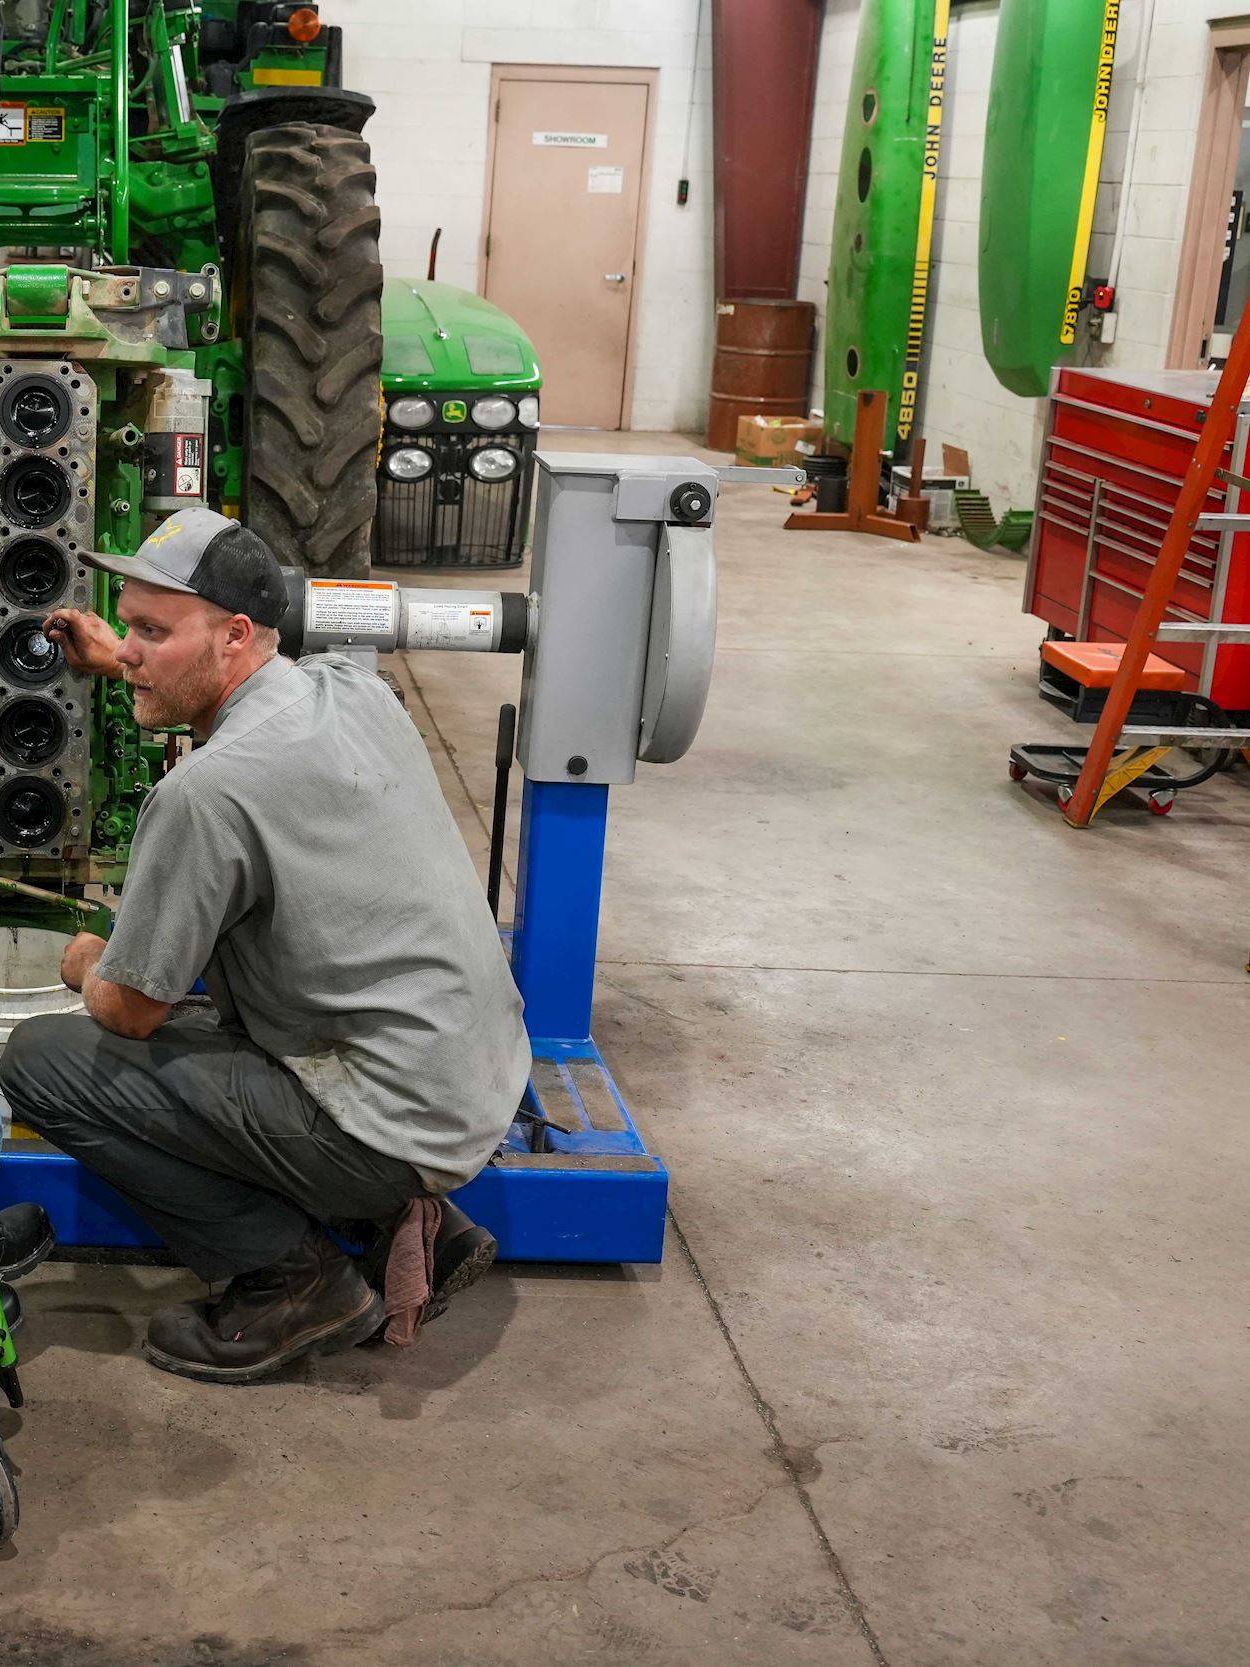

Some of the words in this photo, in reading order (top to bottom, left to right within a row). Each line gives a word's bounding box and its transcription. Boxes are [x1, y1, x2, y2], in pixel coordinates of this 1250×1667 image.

[930, 37, 947, 107] DEERE
[1093, 64, 1112, 123] JOHN
[544, 135, 596, 144] SHOWROOM
[924, 125, 940, 180] JOHN
[1062, 288, 1082, 337] 7810
[897, 371, 918, 440] 4850
